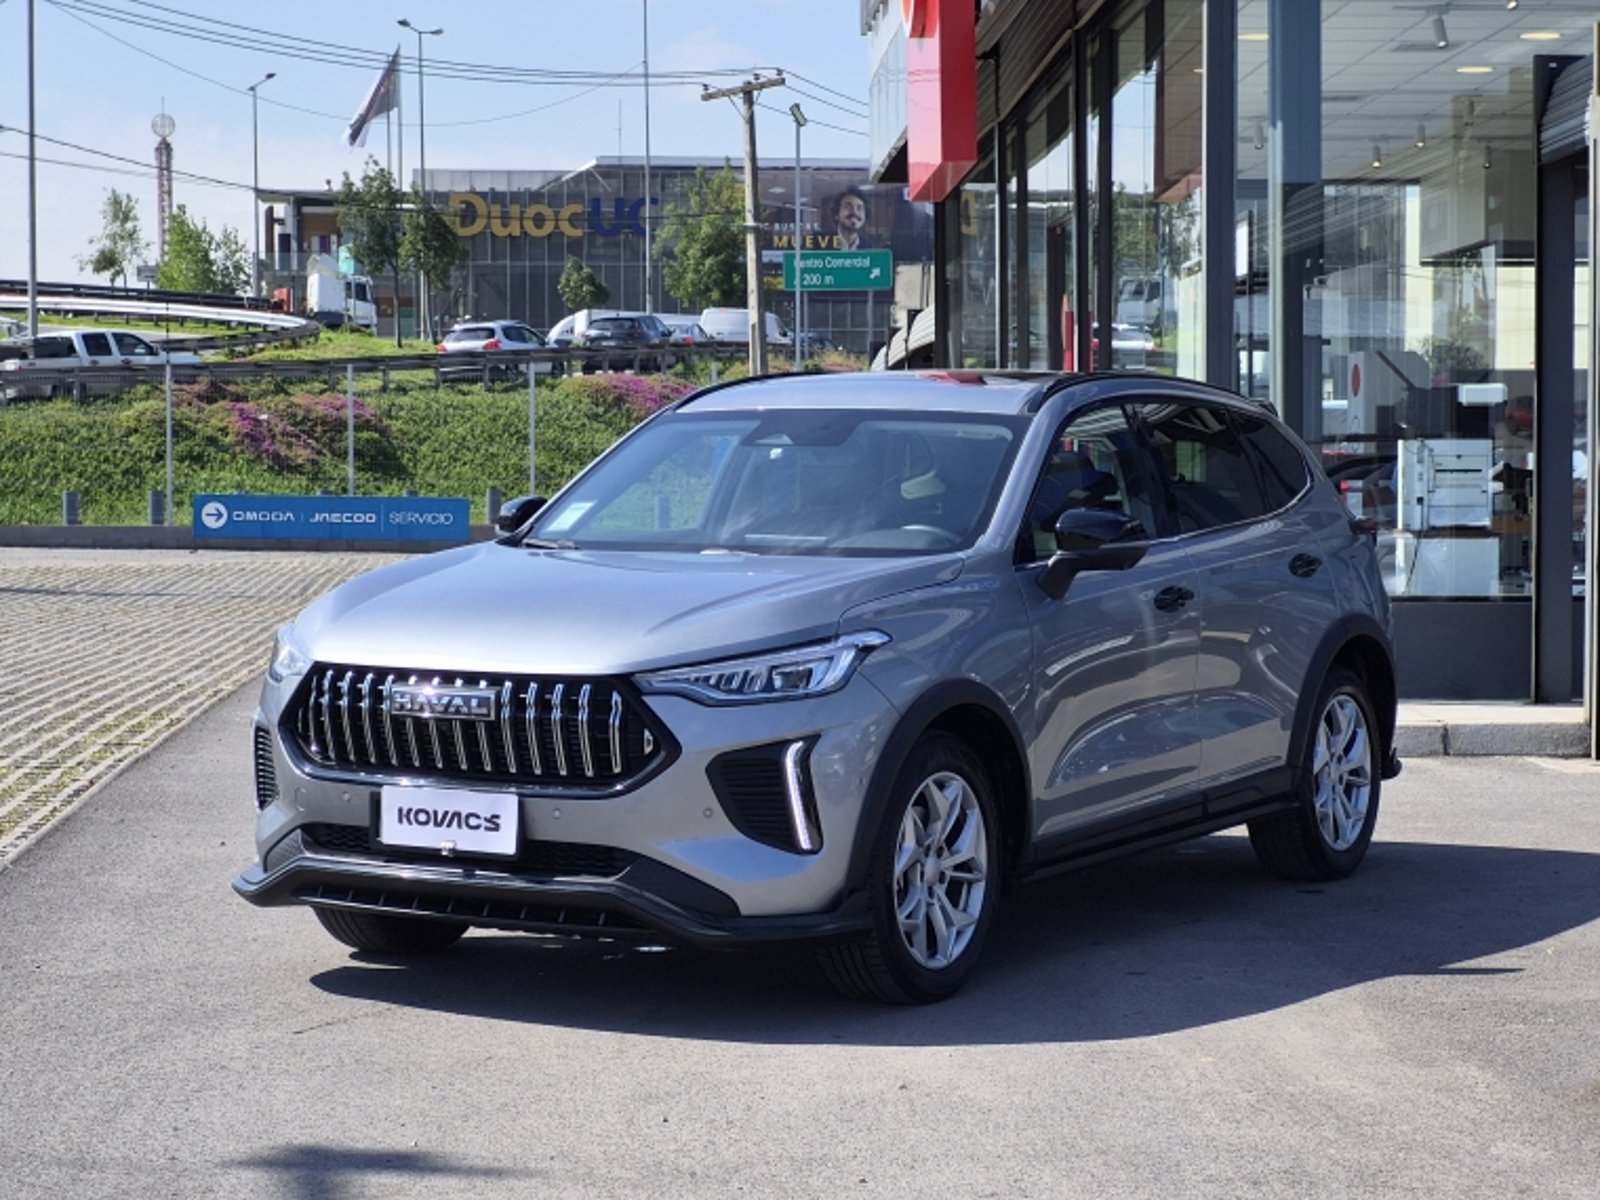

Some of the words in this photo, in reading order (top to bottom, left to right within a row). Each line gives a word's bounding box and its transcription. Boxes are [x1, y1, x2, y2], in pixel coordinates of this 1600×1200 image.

[793, 257, 823, 269] entro
[825, 256, 871, 269] Comercial
[802, 273, 822, 286] 200
[823, 275, 834, 286] m
[232, 511, 296, 522] OMODA
[309, 512, 377, 524] JAECOO
[388, 511, 454, 525] SERVICIO
[393, 692, 489, 715] HAVAL
[397, 806, 501, 833] KOVACS
